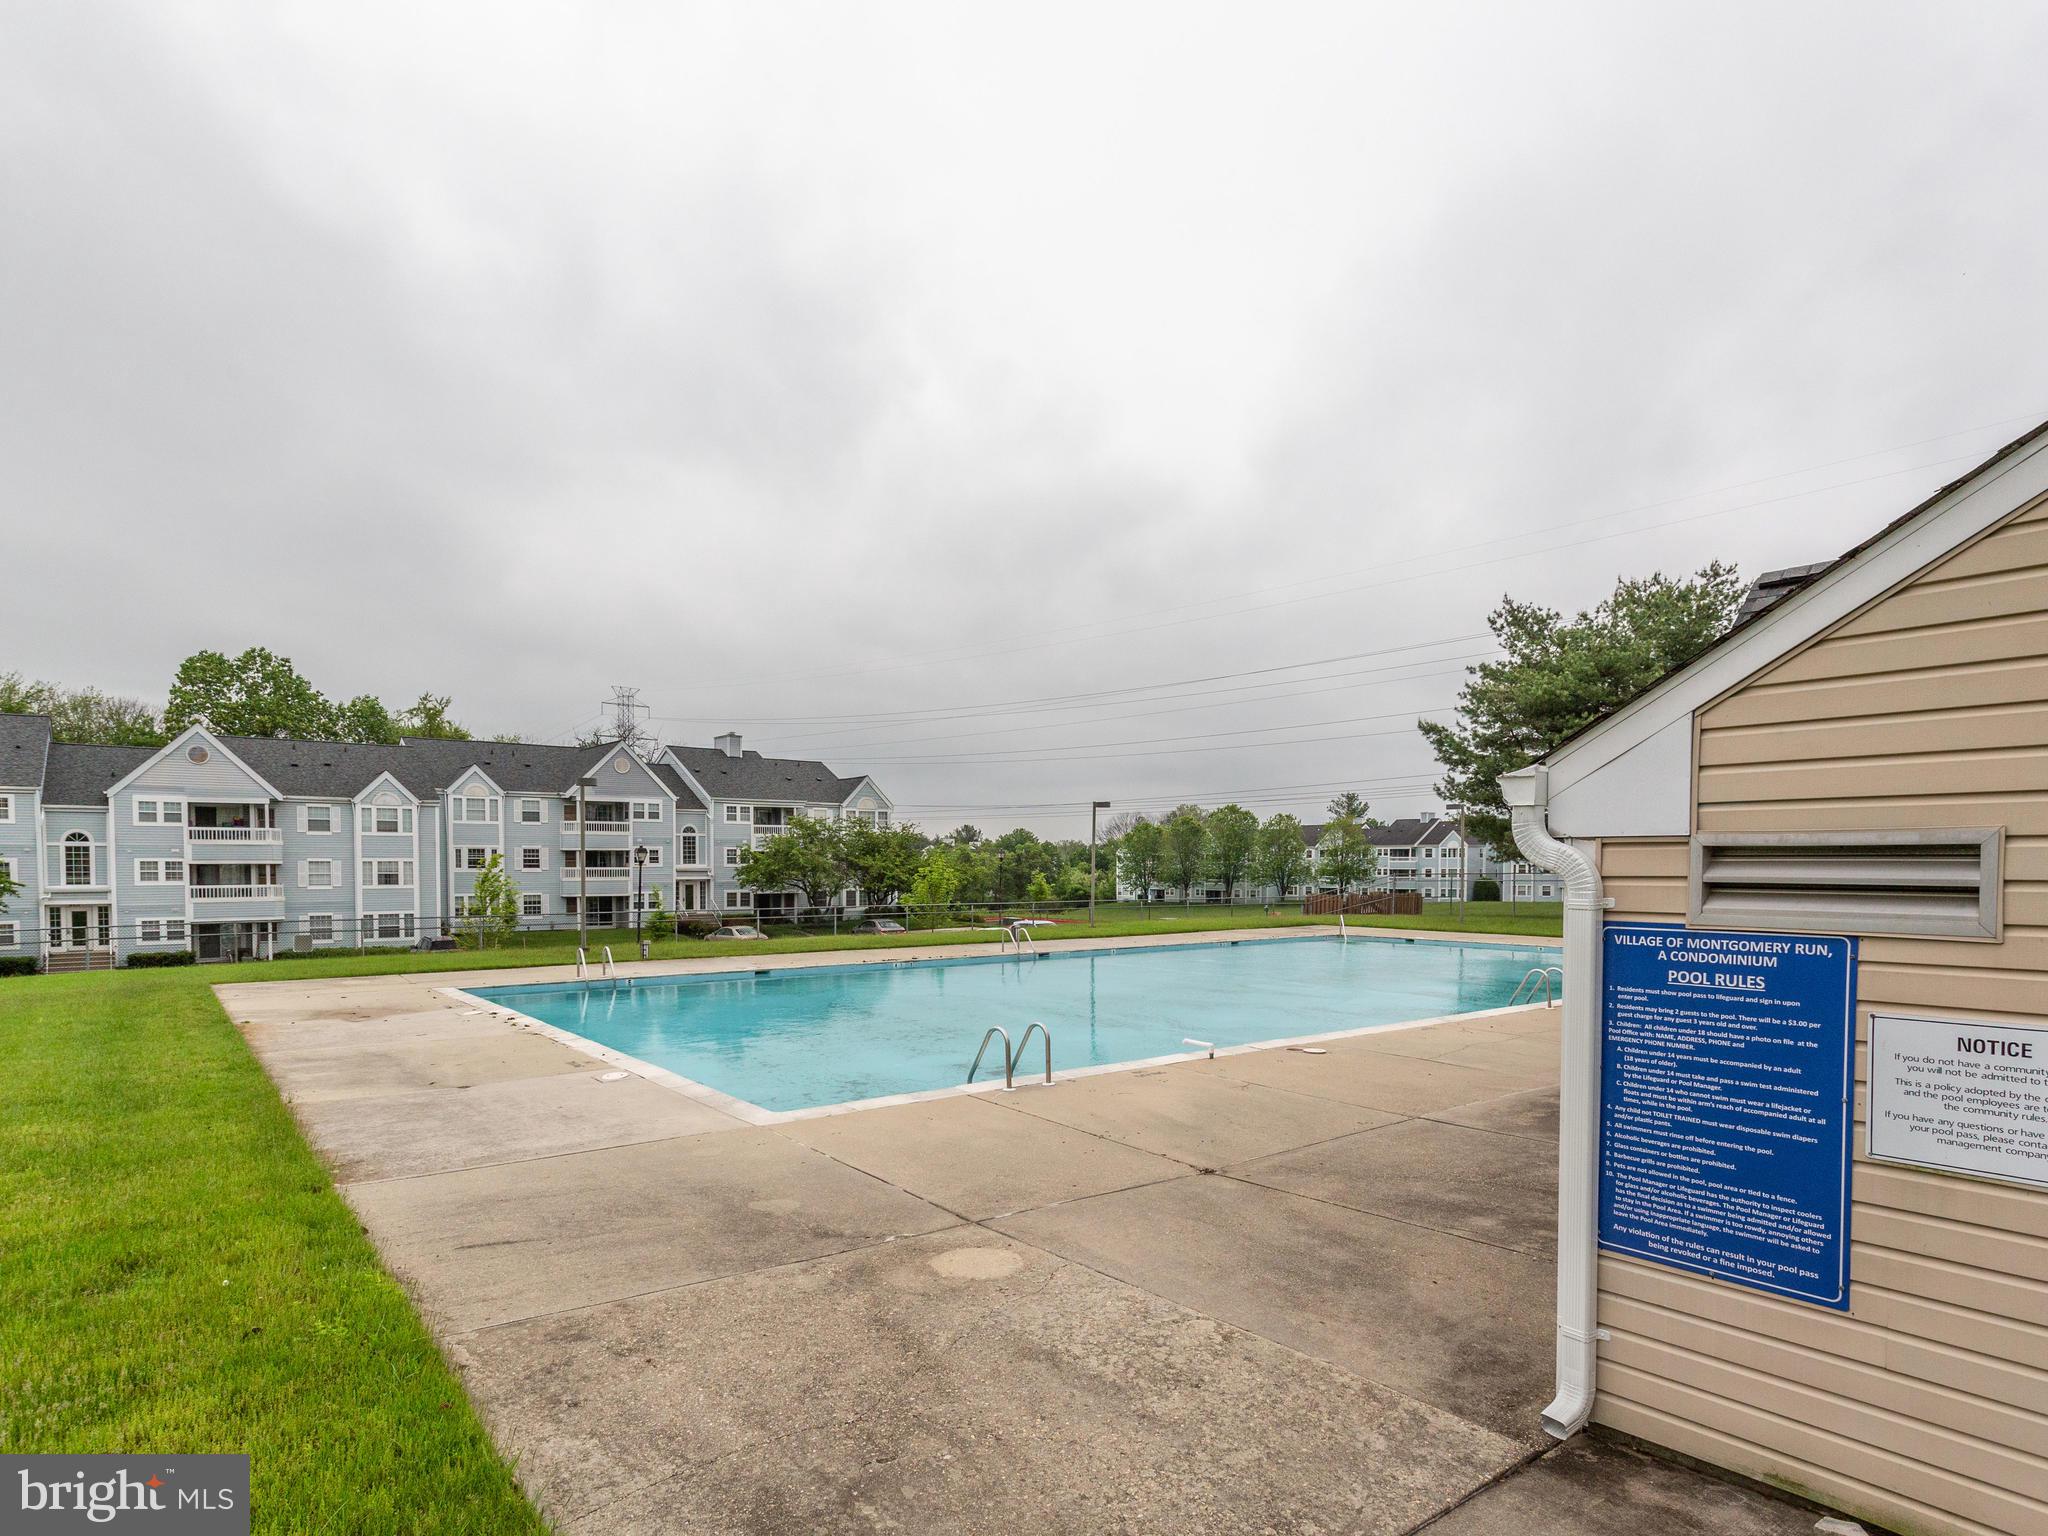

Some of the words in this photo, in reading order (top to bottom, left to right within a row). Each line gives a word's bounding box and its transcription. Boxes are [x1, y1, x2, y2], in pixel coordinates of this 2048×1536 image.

[1614, 934, 1663, 946] VILLAGE
[1666, 937, 1683, 947] OF
[1687, 938, 1791, 953] MONTGOMERY
[1795, 943, 1832, 957] RUN,
[1657, 950, 1667, 960] A
[1670, 950, 1777, 967] CONDOMINIUM
[1668, 970, 1710, 984] POOL
[1714, 973, 1765, 989] RULES
[1616, 985, 1644, 993] Residents
[1715, 993, 1744, 1001] lifeguard
[1759, 997, 1773, 1005] sign
[1616, 1003, 1644, 1011] Residents
[1738, 1014, 1757, 1022] There
[1787, 1019, 1807, 1027] $3.00
[1633, 1012, 1653, 1020] charge
[1957, 1037, 2032, 1058] NOTICE
[1623, 1046, 1648, 1054] Children
[1719, 1059, 1762, 1069] accompanied
[1763, 1063, 1772, 1071] by
[1657, 1059, 1677, 1067] older).
[1894, 1052, 1900, 1060] If
[1922, 1055, 1935, 1064] do
[1957, 1059, 1980, 1069] have
[1926, 1066, 1942, 1074] will
[1964, 1069, 1977, 1078] be
[1980, 1072, 2027, 1083] admitted
[2029, 1077, 2040, 1085] to
[1895, 1077, 1912, 1086] This
[1915, 1079, 1922, 1087] is
[1933, 1083, 1961, 1094] policy
[1963, 1086, 2006, 1097] adopted
[2008, 1090, 2021, 1101] by
[2023, 1093, 2041, 1102] the
[1922, 1090, 1938, 1099] the
[1941, 1094, 1963, 1102] pool
[1966, 1097, 2020, 1109] employees
[1943, 1102, 1959, 1111] the
[1962, 1106, 2019, 1120] community
[1892, 1112, 1909, 1120] you
[1912, 1113, 1934, 1123] have
[1937, 1118, 1954, 1128] any
[1956, 1121, 2004, 1133] questions
[2020, 1128, 2045, 1139] have
[1909, 1124, 1929, 1132] your
[1931, 1127, 1953, 1136] pool
[1956, 1131, 1979, 1140] pass,
[1982, 1134, 2014, 1145] please
[1614, 1132, 1640, 1141] Alcoholic
[1640, 1136, 1670, 1147] beverages
[1681, 1145, 1716, 1155] prohibited.
[1623, 1124, 1652, 1133] swimmers
[1694, 1136, 1715, 1145] before
[1716, 1141, 1743, 1151] entering
[1936, 1138, 2001, 1153] management
[1629, 1146, 1659, 1155] containers
[1668, 1151, 1689, 1161] bottles
[1701, 1159, 1736, 1170] prohibited.
[1613, 1223, 1627, 1233] Any
[1628, 1227, 1660, 1240] violation
[1670, 1237, 1684, 1246] the
[1685, 1241, 1704, 1251] rules
[1721, 1250, 1744, 1261] result
[1746, 1255, 1754, 1263] in
[1756, 1258, 1776, 1268] your
[1777, 1264, 1797, 1273] pool
[1799, 1269, 1818, 1279] pass
[1648, 1240, 1669, 1252] being
[1670, 1247, 1700, 1259] revoked
[1719, 1257, 1735, 1268] fine
[1736, 1262, 1774, 1278] imposed.
